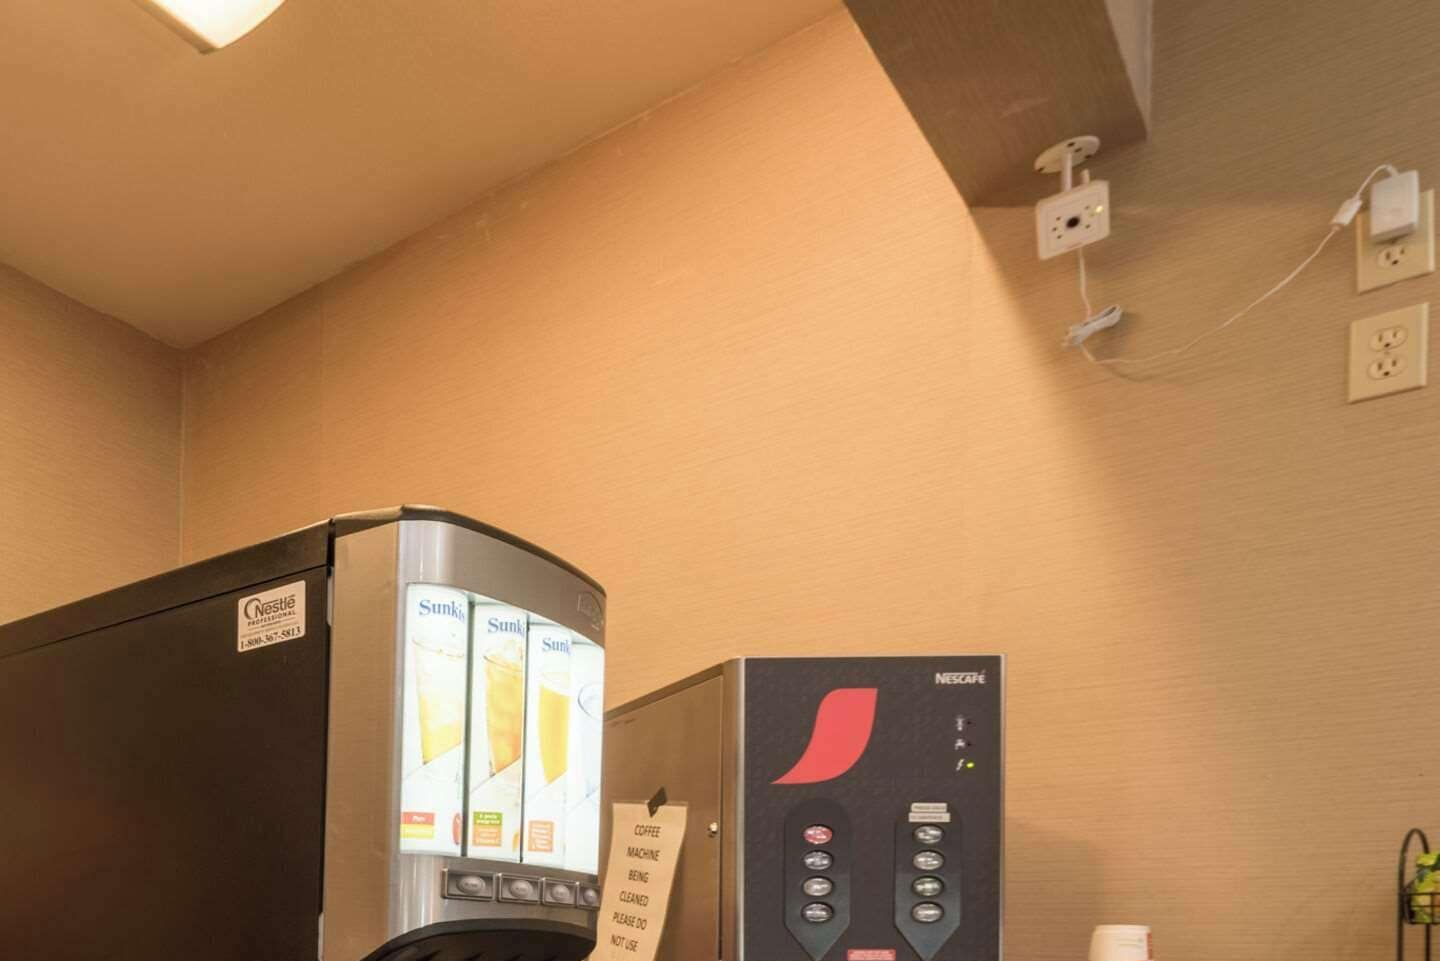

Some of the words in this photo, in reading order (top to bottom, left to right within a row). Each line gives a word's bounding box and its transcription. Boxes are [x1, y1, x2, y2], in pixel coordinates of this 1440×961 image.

[248, 611, 296, 626] PROFESSIONAL
[634, 823, 661, 838] COFFEE
[626, 846, 660, 862] MACHINE
[628, 869, 649, 884] BEING
[619, 890, 649, 907] CLEANED
[612, 911, 636, 929] PLEASE
[635, 917, 648, 931] DO
[610, 934, 625, 948] NOT
[625, 938, 639, 952] USE
